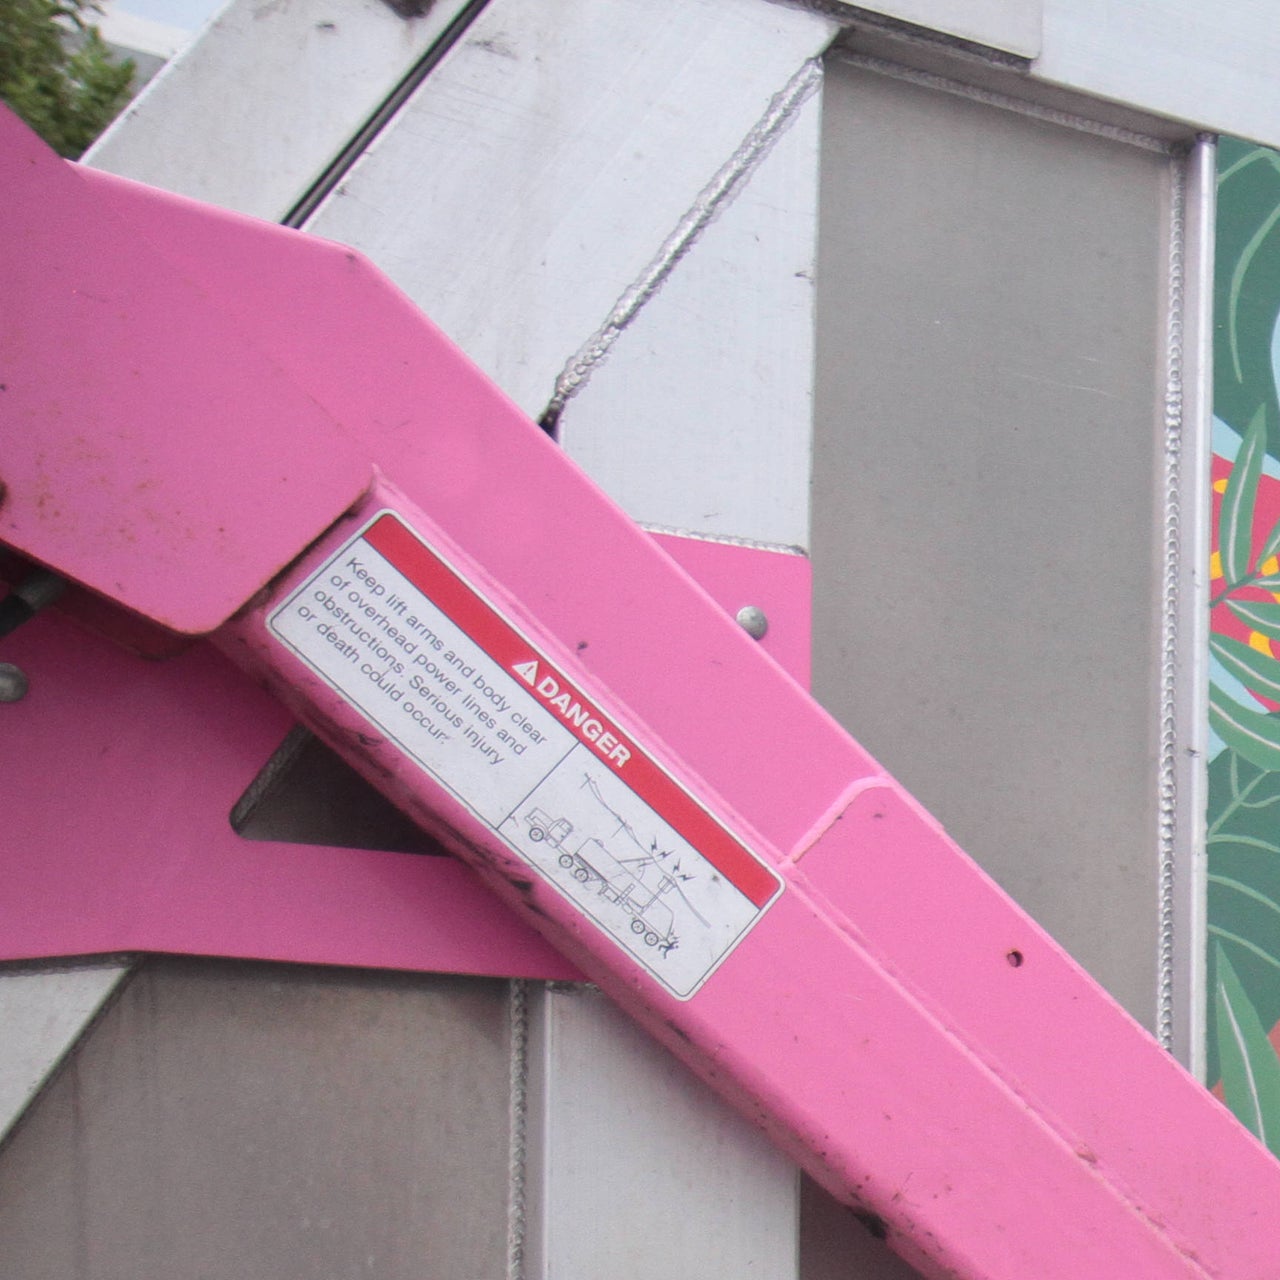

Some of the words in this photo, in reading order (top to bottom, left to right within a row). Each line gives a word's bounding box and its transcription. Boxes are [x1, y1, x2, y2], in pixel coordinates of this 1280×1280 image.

[297, 606, 317, 623] or
[317, 622, 361, 665] death
[361, 663, 404, 702] could
[403, 701, 449, 745] occur.
[314, 590, 405, 678] obstructions.
[409, 675, 464, 729] Serious
[463, 725, 505, 765] injury
[330, 575, 351, 592] of
[348, 591, 418, 655] overhead
[413, 653, 462, 696] power
[462, 694, 497, 730] lines
[497, 727, 528, 756] and
[346, 557, 386, 597] Keep
[386, 593, 408, 616] lift
[406, 615, 444, 651] arms
[444, 650, 475, 678] and
[473, 675, 511, 713] body
[511, 711, 547, 746] clear
[536, 676, 631, 768] DANGER
